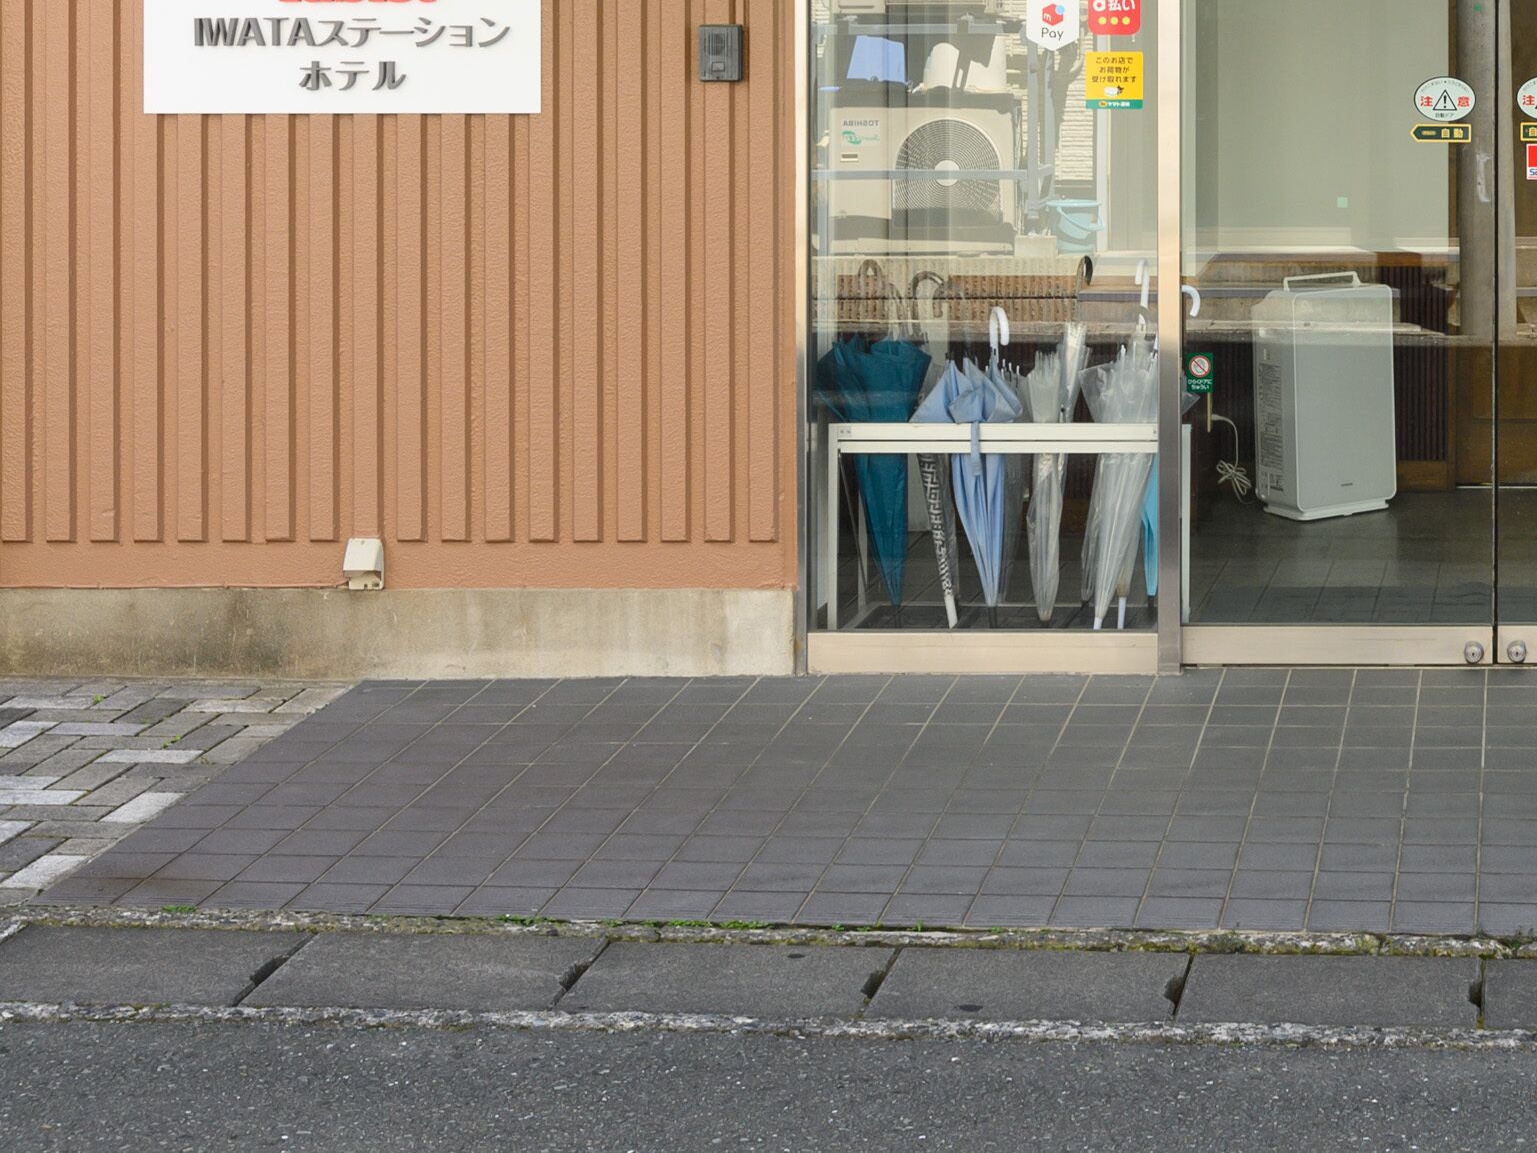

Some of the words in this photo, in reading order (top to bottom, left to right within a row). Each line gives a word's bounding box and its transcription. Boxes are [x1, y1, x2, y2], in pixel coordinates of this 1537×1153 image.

[193, 16, 511, 49] IWATAステーション
[1041, 27, 1064, 40] Pay
[1095, 56, 1134, 65] このお店で
[298, 60, 407, 92] ホテル
[1091, 75, 1137, 83] 受け取れます
[1441, 127, 1464, 139] 自動
